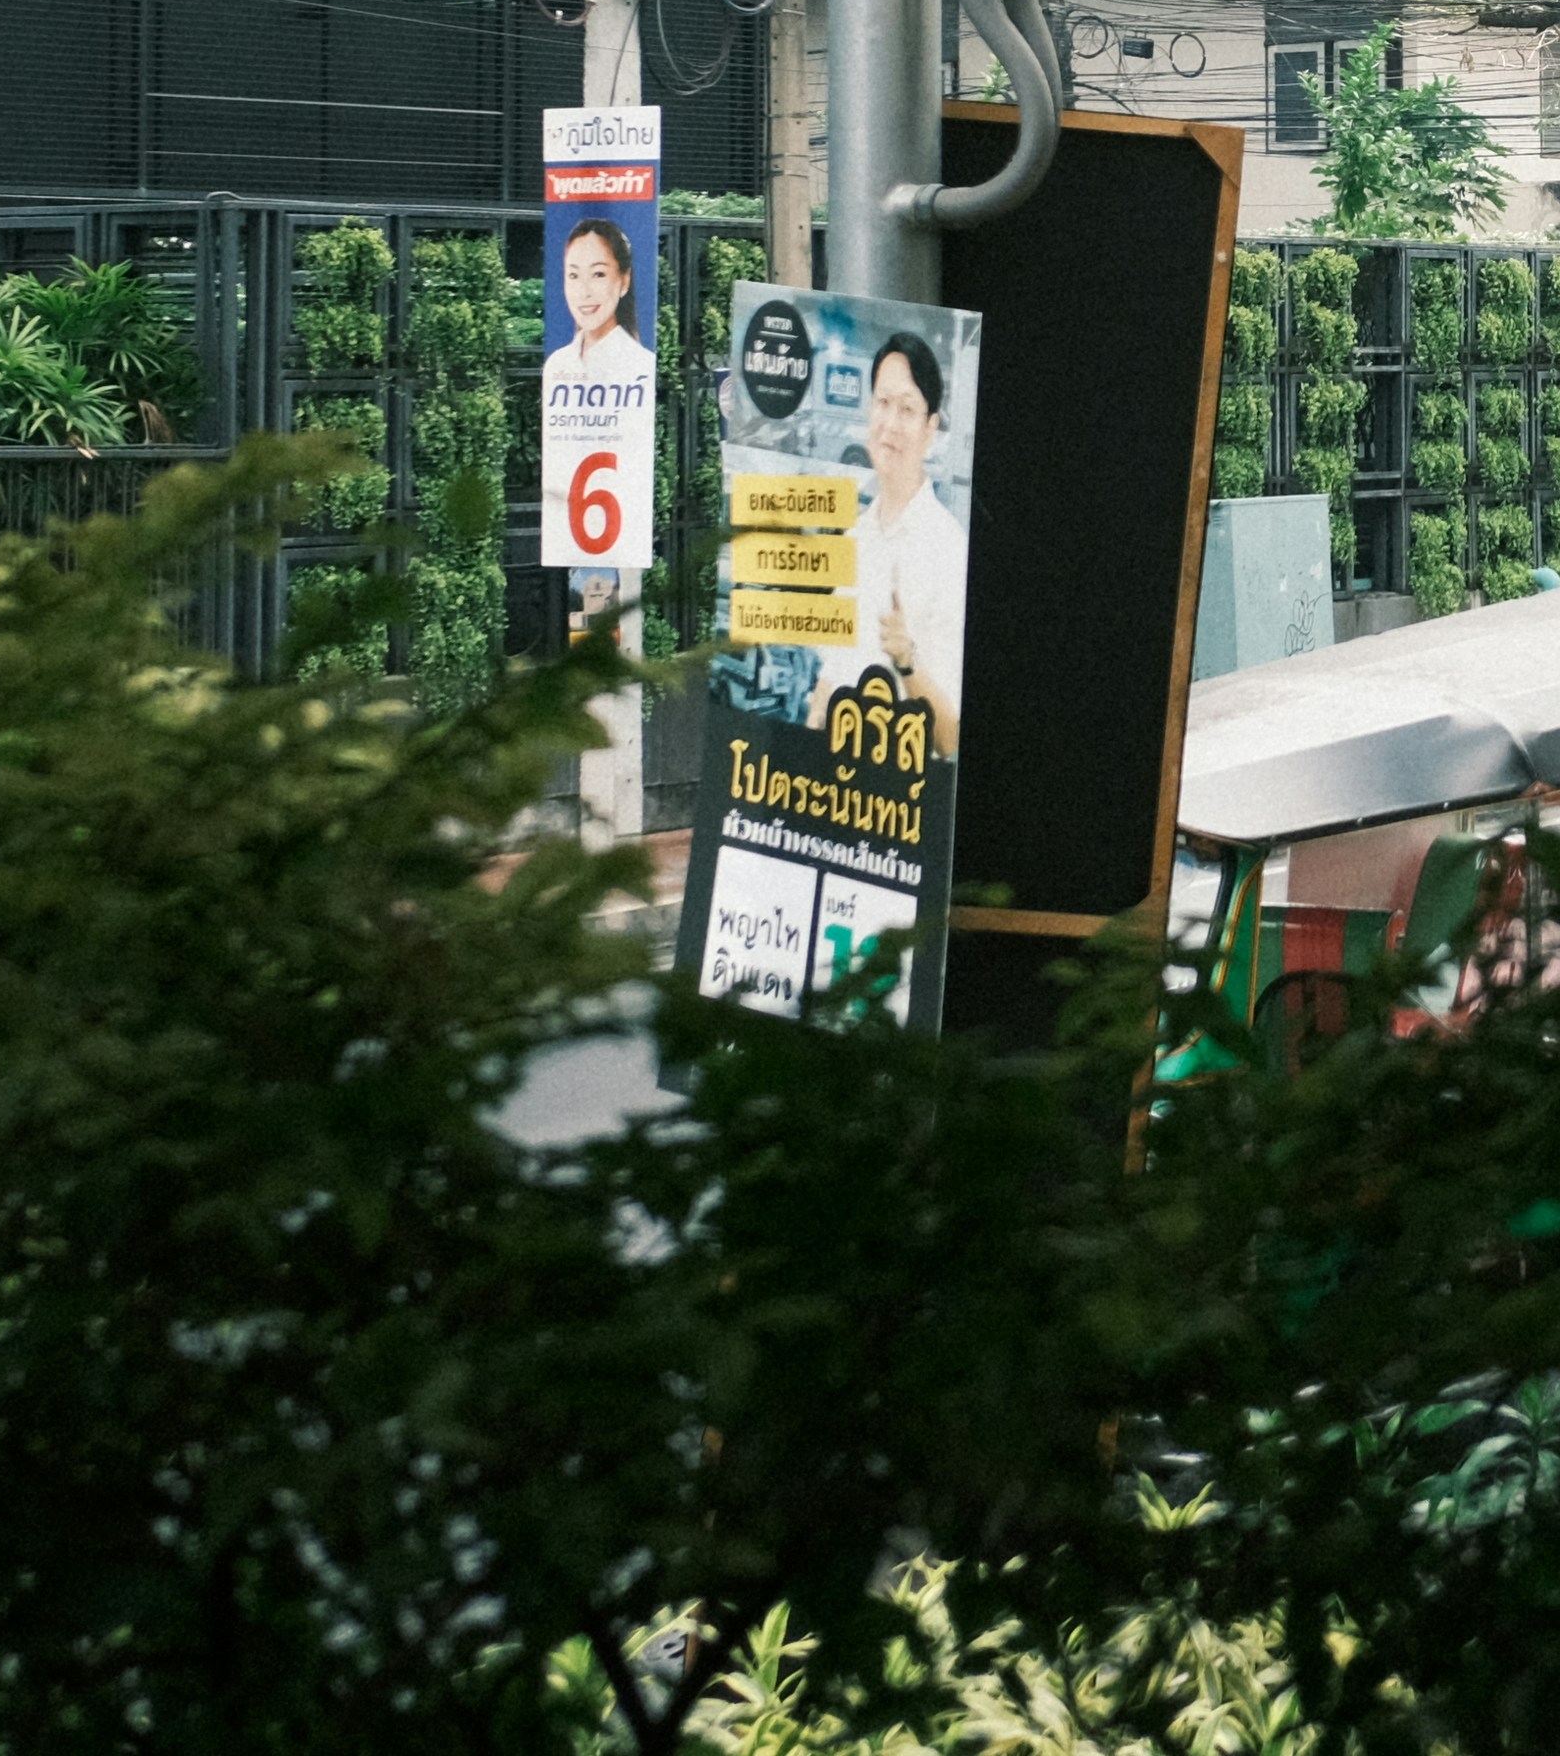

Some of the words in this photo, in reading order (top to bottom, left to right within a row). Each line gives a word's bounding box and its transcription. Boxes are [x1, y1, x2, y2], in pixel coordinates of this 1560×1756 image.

[566, 116, 653, 154] ภูมิใจไทย
[744, 339, 809, 381] เส้นด้าย
[567, 451, 622, 555] 6
[757, 543, 830, 573] การรักษา
[739, 604, 854, 636] ไม่ต้องจ่ายส่วนต่าง
[830, 677, 927, 775] คริส
[729, 738, 926, 845] โปตระนันทน์
[722, 807, 923, 887] หัวหน้าพรรคเส้นด้าย
[827, 894, 858, 919] เบอร์
[719, 906, 801, 952] พญาไท
